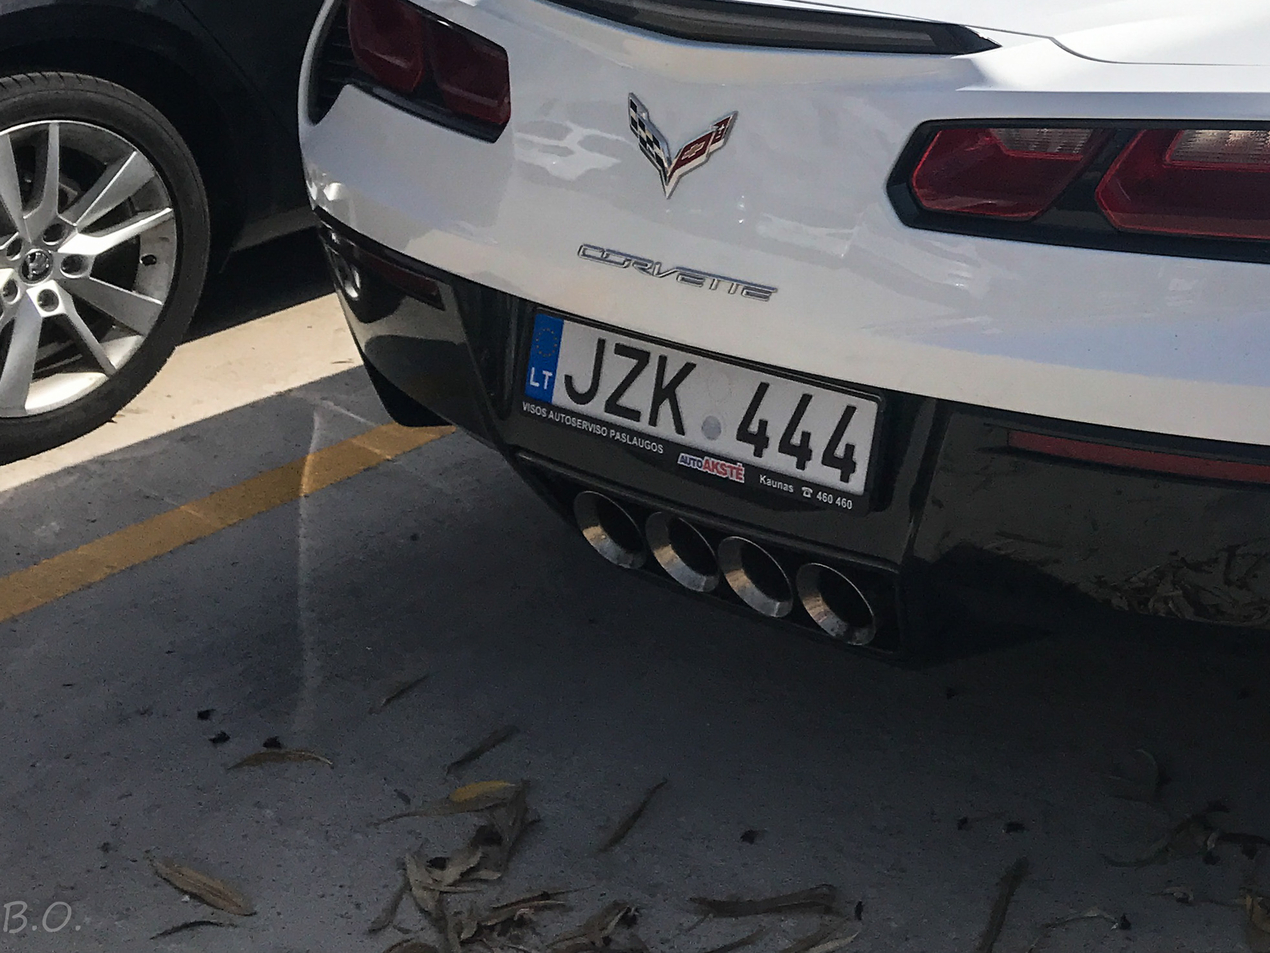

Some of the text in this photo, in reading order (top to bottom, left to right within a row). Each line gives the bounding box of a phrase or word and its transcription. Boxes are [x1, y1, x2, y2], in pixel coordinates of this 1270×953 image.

[577, 244, 778, 302] CORVETTE
[529, 367, 552, 390] LT
[522, 401, 664, 454] VISOS AUTOSERVISO PASLAUGOS
[564, 338, 857, 483] JZK 444
[759, 474, 853, 510] Kaunas 460 460
